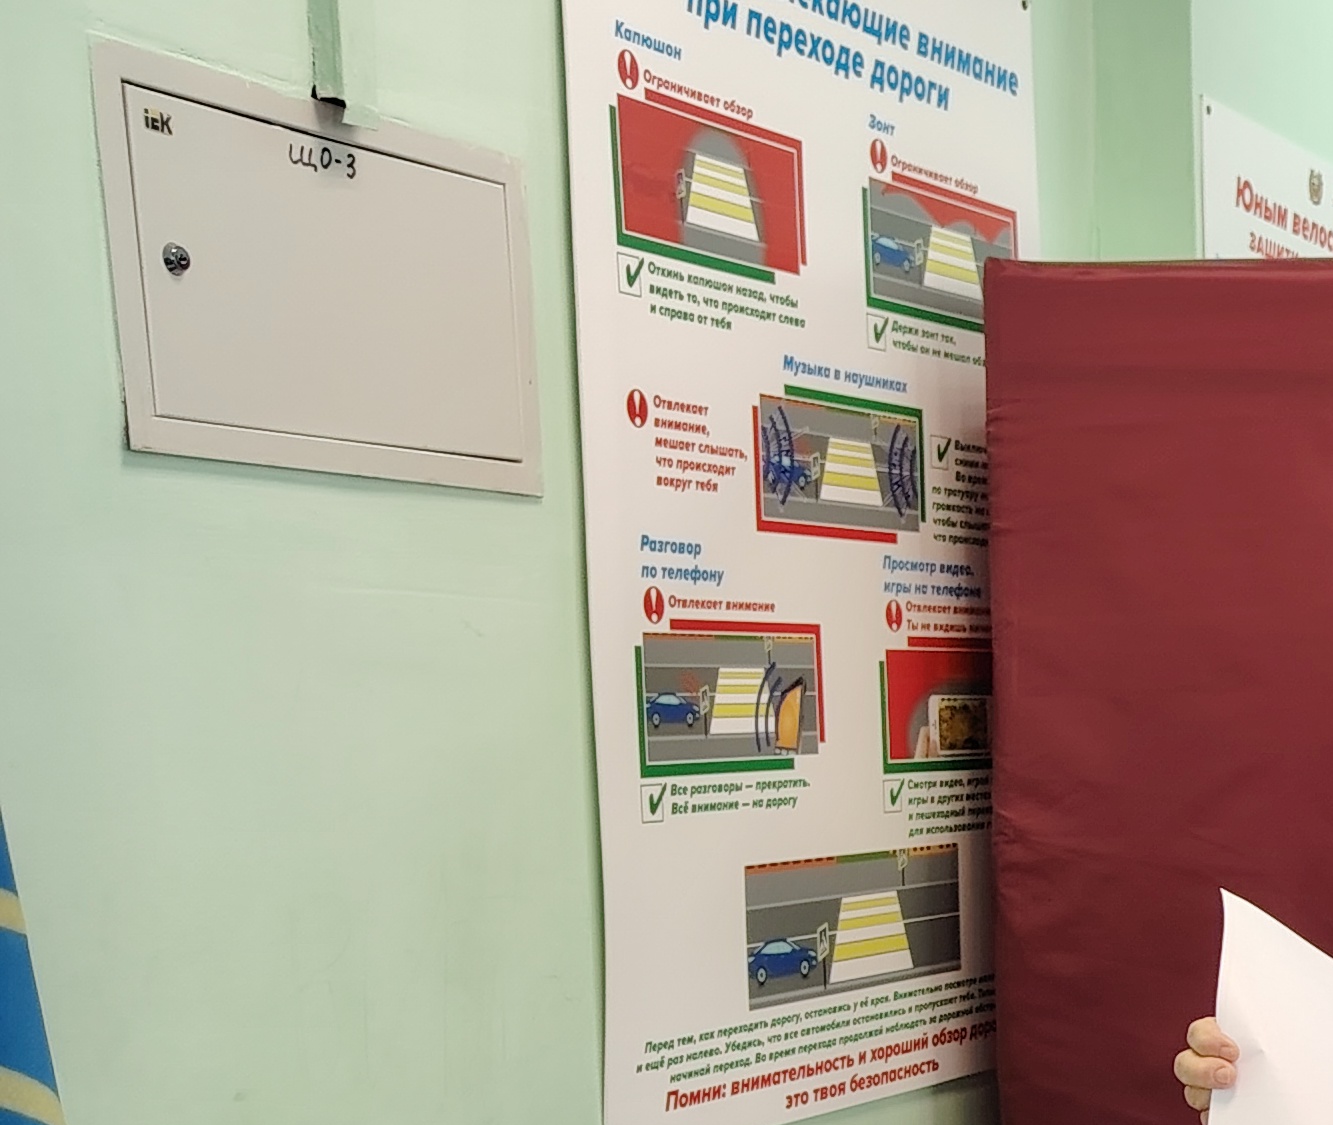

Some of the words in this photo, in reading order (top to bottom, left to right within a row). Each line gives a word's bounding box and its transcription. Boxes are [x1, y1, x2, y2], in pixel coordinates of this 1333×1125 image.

[615, 20, 682, 60] Капюшон
[789, 0, 910, 50] кающие
[917, 31, 1019, 96] внимание
[746, 8, 864, 79] переходе
[870, 59, 950, 111] дороги
[643, 69, 720, 106] Ограничивает
[723, 100, 753, 120] обзор
[869, 114, 895, 136] Зонт
[1236, 175, 1288, 231] Юным
[648, 262, 685, 281] Откинь
[687, 273, 734, 294] капюшон
[736, 285, 767, 303] назад,
[769, 293, 799, 308] чтобы
[649, 284, 684, 300] видеть
[687, 292, 700, 307] то,
[703, 296, 719, 309] что
[721, 300, 776, 322] происходит
[778, 314, 806, 328] слева
[650, 304, 656, 314] и
[659, 305, 695, 322] справа
[697, 315, 707, 325] от
[710, 317, 732, 330] тебя
[891, 320, 919, 336] Держи
[921, 328, 939, 340] зонт
[892, 338, 918, 353] чтобы
[932, 349, 941, 358] не
[783, 354, 831, 378] Музыка
[834, 368, 841, 380] в
[844, 370, 908, 393] наушниках
[653, 395, 709, 416] Отвлекает
[654, 417, 710, 438] внимание,
[655, 436, 696, 452] мешает
[698, 443, 748, 461] слышать,
[656, 456, 674, 468] что
[676, 459, 736, 476] происходит
[656, 475, 692, 492] вокруг
[696, 478, 718, 492] тебя
[640, 534, 702, 559] Разговор
[641, 565, 657, 578] по
[661, 564, 724, 587] телефону
[883, 555, 936, 576] Просмотр
[884, 581, 912, 597] игры
[915, 583, 928, 595] на
[931, 582, 982, 600] телефоне
[668, 595, 723, 610] Отвлекает
[726, 601, 775, 613] внимание
[906, 600, 951, 614] Отвлекает
[907, 619, 918, 631] Ты
[921, 622, 931, 632] не
[670, 783, 688, 797] Все
[690, 782, 743, 798] разговоры
[908, 779, 937, 790] Смотри
[671, 801, 689, 815] Всё
[691, 800, 739, 813] внимание
[752, 799, 763, 809] на
[766, 796, 798, 810] дорогу
[908, 796, 928, 807] игры
[908, 827, 924, 838] для
[644, 1039, 675, 1054] Перед
[677, 1035, 696, 1047] тем,
[699, 1030, 715, 1042] как
[717, 1020, 768, 1038] переходить
[770, 1013, 802, 1028] дорогу,
[804, 1003, 851, 1020] остановись
[853, 1001, 858, 1013] у
[860, 996, 869, 1008] её
[893, 984, 942, 1001] Внимательно
[636, 1063, 642, 1073] и
[645, 1056, 665, 1073] ещё
[667, 1054, 683, 1069] раз
[686, 1047, 722, 1063] налево.
[725, 1038, 765, 1054] Убедись,
[767, 1035, 782, 1044] что
[784, 1031, 798, 1041] все
[801, 1019, 850, 1037] автомобили
[852, 1008, 906, 1026] остановились
[914, 996, 957, 1013] пропускают
[669, 1064, 711, 1084] начинай
[712, 1058, 752, 1073] переход.
[755, 1052, 766, 1064] Во
[768, 1046, 796, 1062] время
[798, 1038, 836, 1054] перехода
[839, 1025, 883, 1046] продолжай
[885, 1019, 927, 1034] наблюдать
[929, 1016, 937, 1024] за
[665, 1083, 727, 1112] Помни:
[731, 1054, 854, 1096] внимательность
[858, 1051, 867, 1066] и
[870, 1032, 928, 1063] хороший
[932, 1026, 967, 1046] обзор
[785, 1090, 808, 1110] это
[813, 1082, 846, 1103] твоя
[850, 1058, 939, 1093] безопасность
